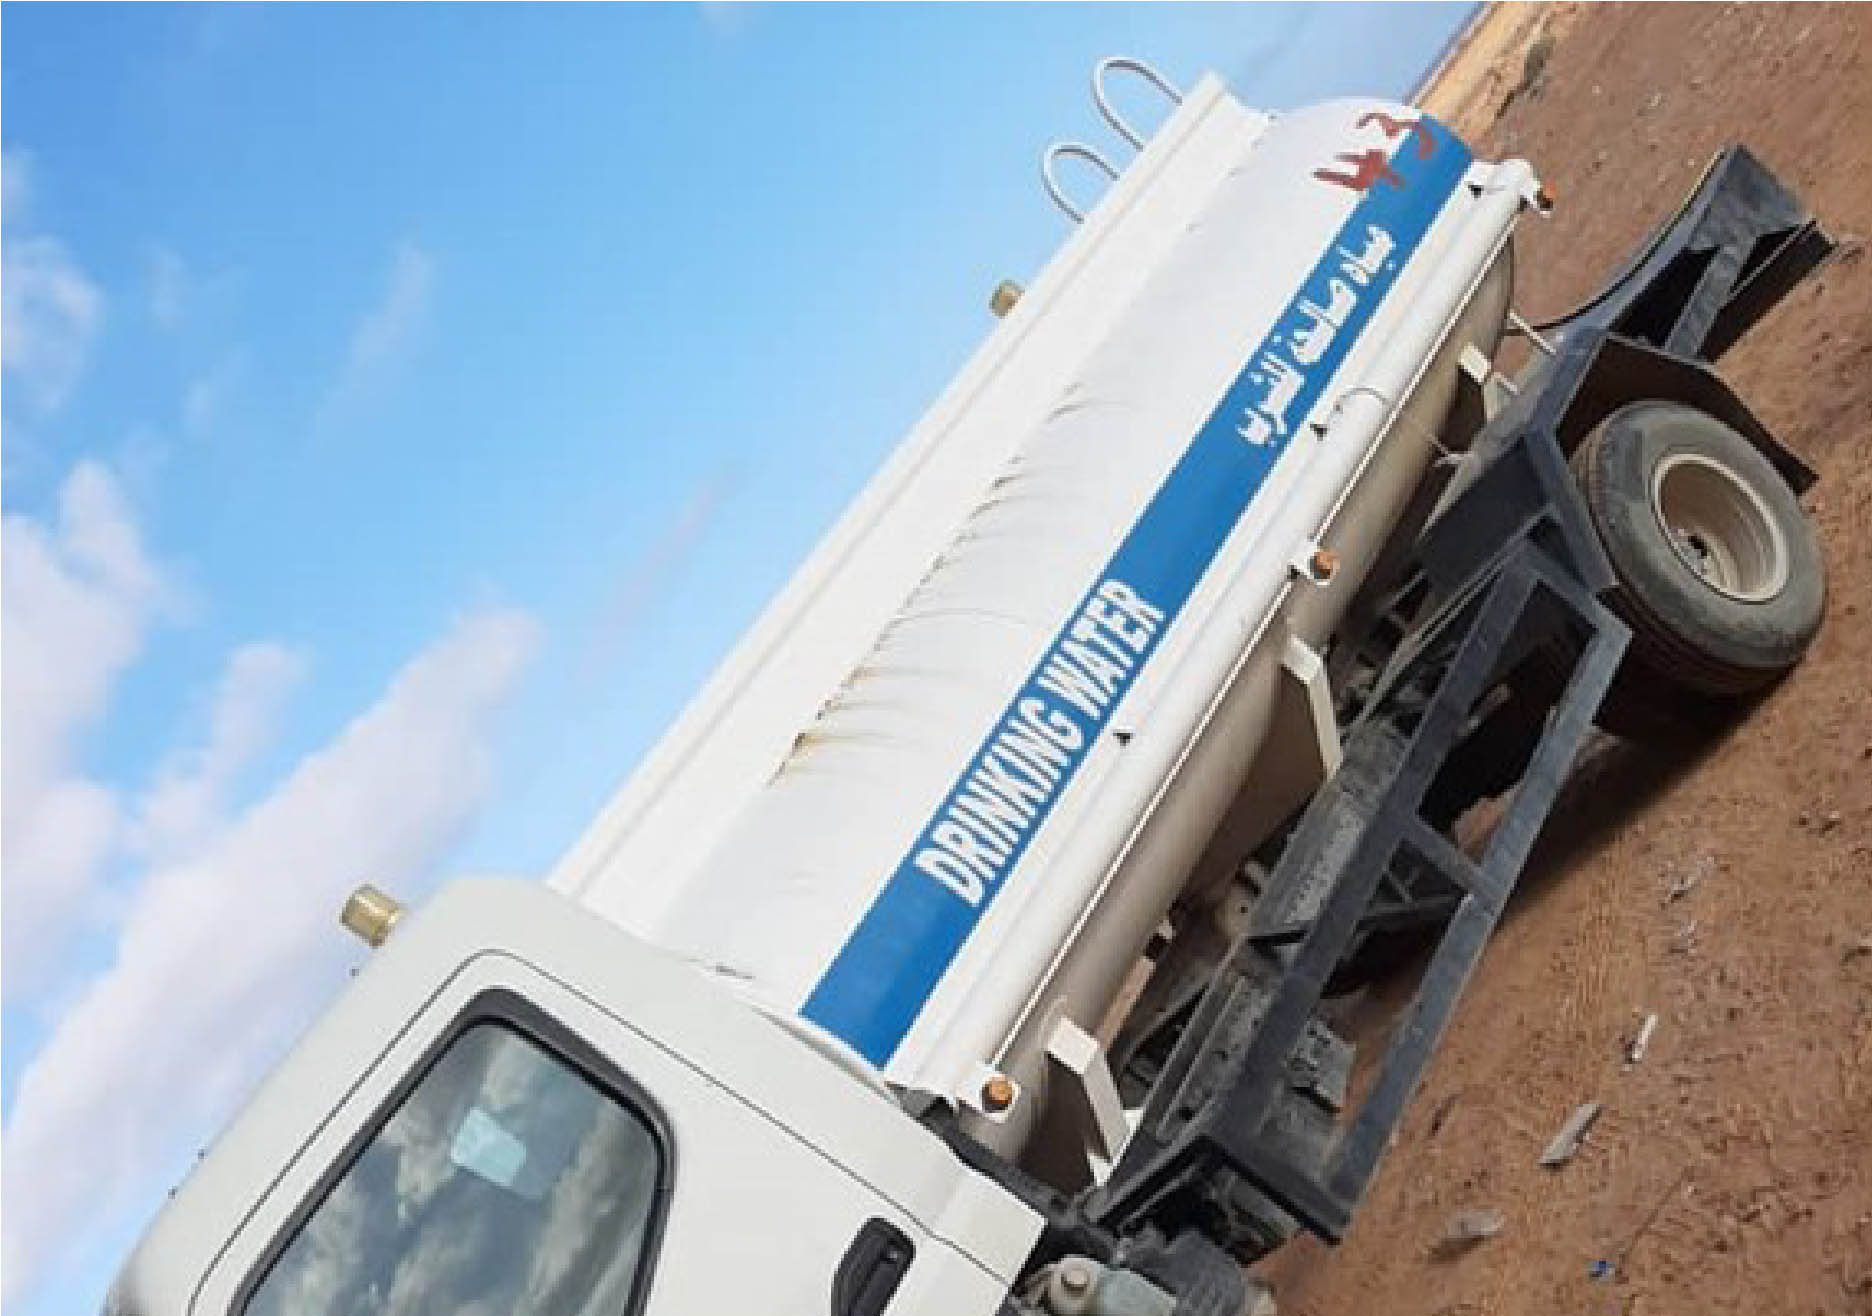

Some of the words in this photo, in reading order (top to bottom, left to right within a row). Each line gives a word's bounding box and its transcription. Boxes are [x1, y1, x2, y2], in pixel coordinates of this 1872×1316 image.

[1339, 224, 1397, 286] مياه
[912, 696, 1085, 913] DRINKING
[1037, 578, 1167, 721] WATER
